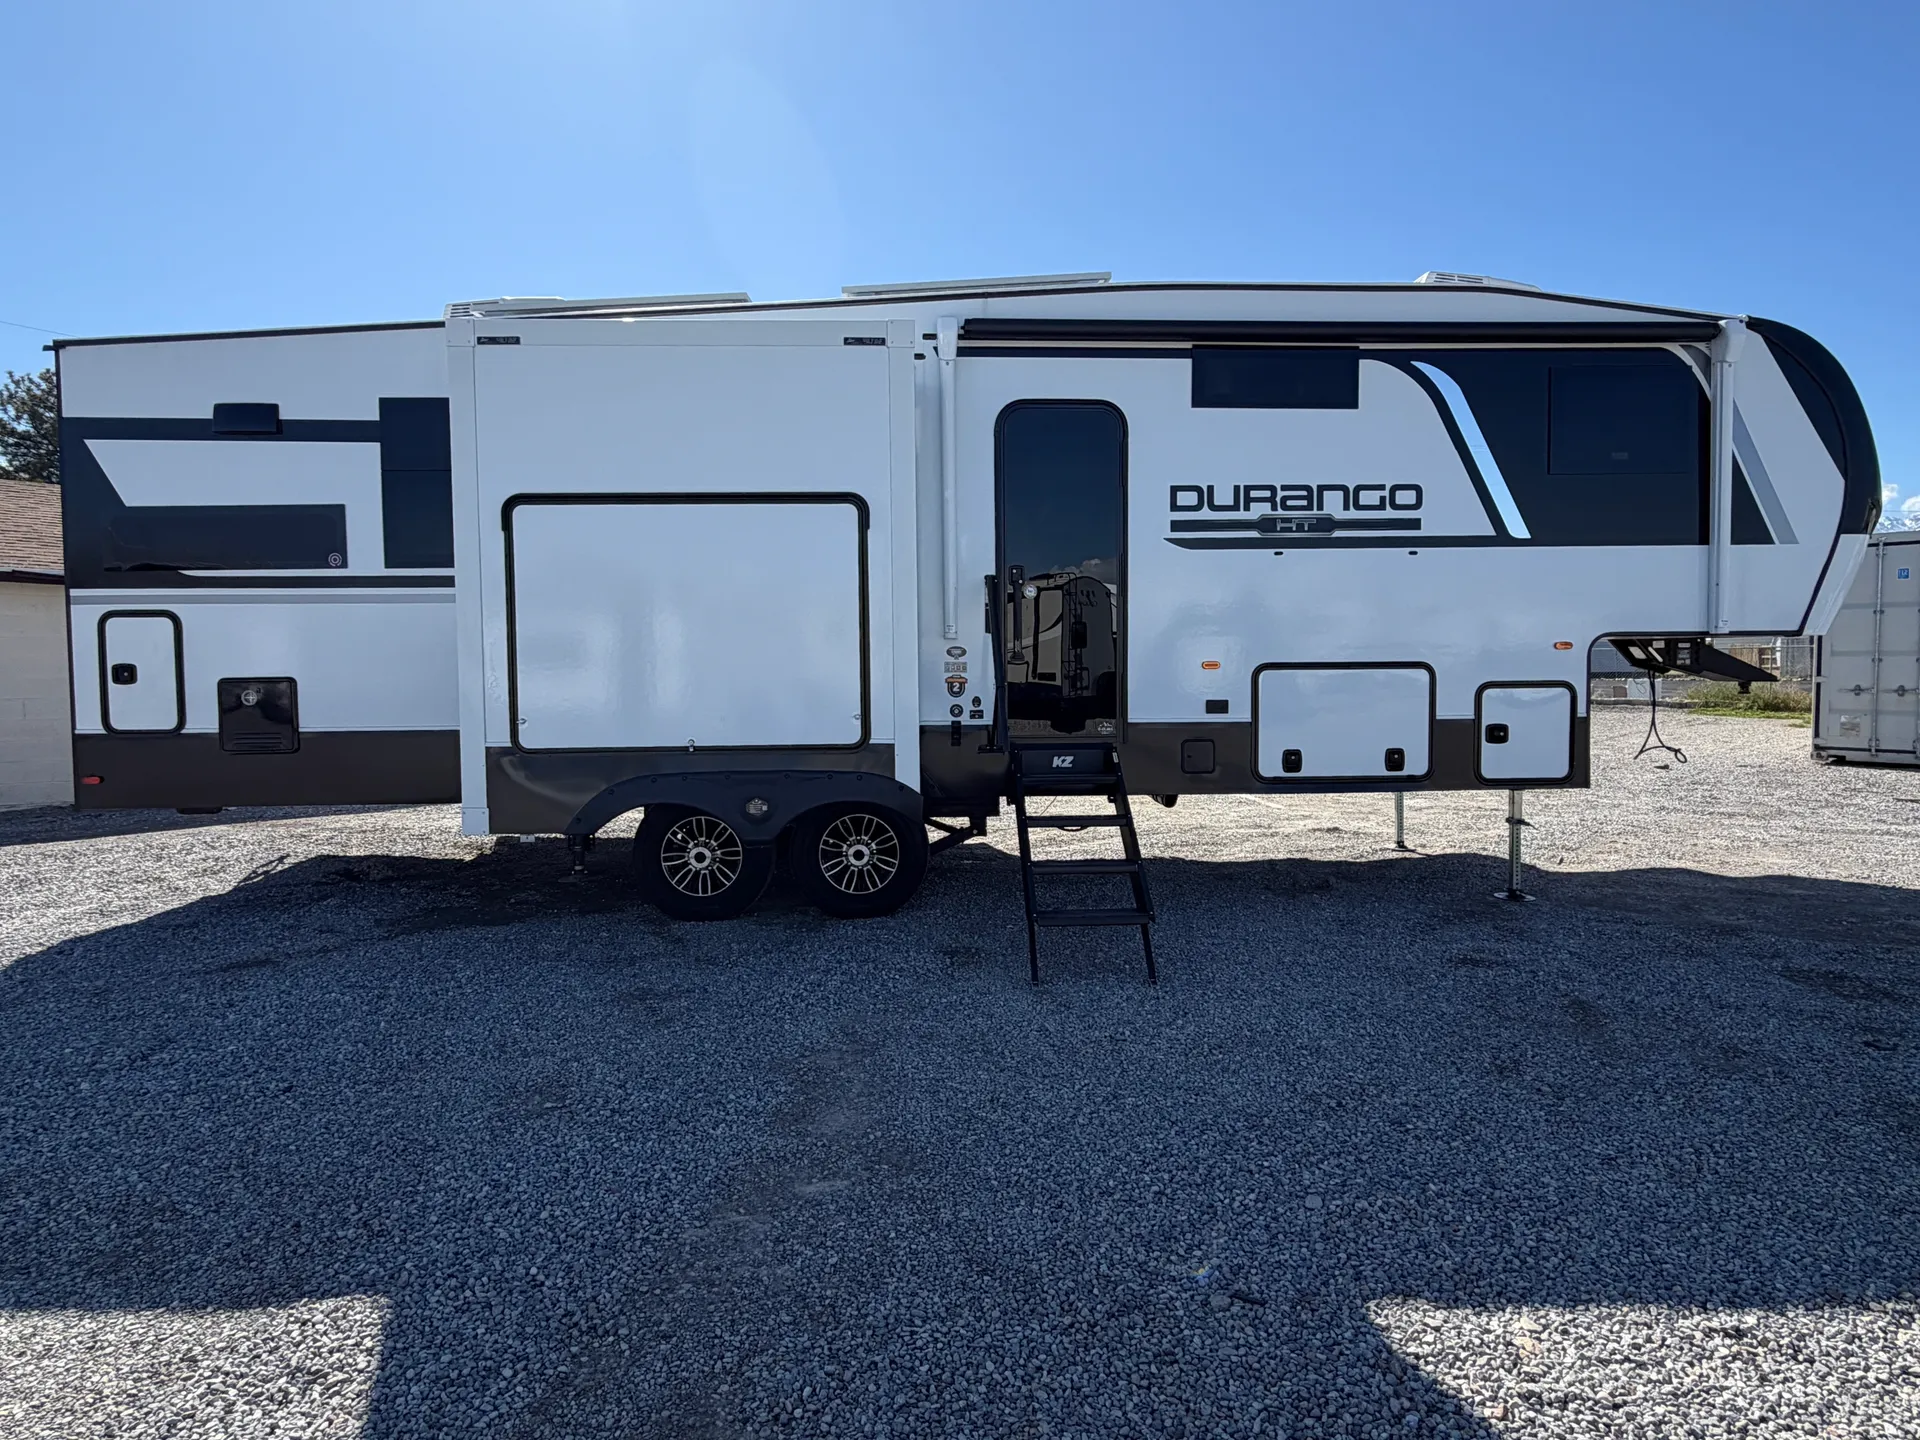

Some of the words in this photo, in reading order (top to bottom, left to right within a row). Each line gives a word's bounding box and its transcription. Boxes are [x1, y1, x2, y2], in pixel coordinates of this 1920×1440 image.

[1170, 484, 1423, 511] DURANGO
[1276, 518, 1316, 531] HT
[952, 682, 960, 692] 2
[1052, 756, 1074, 768] KZ
